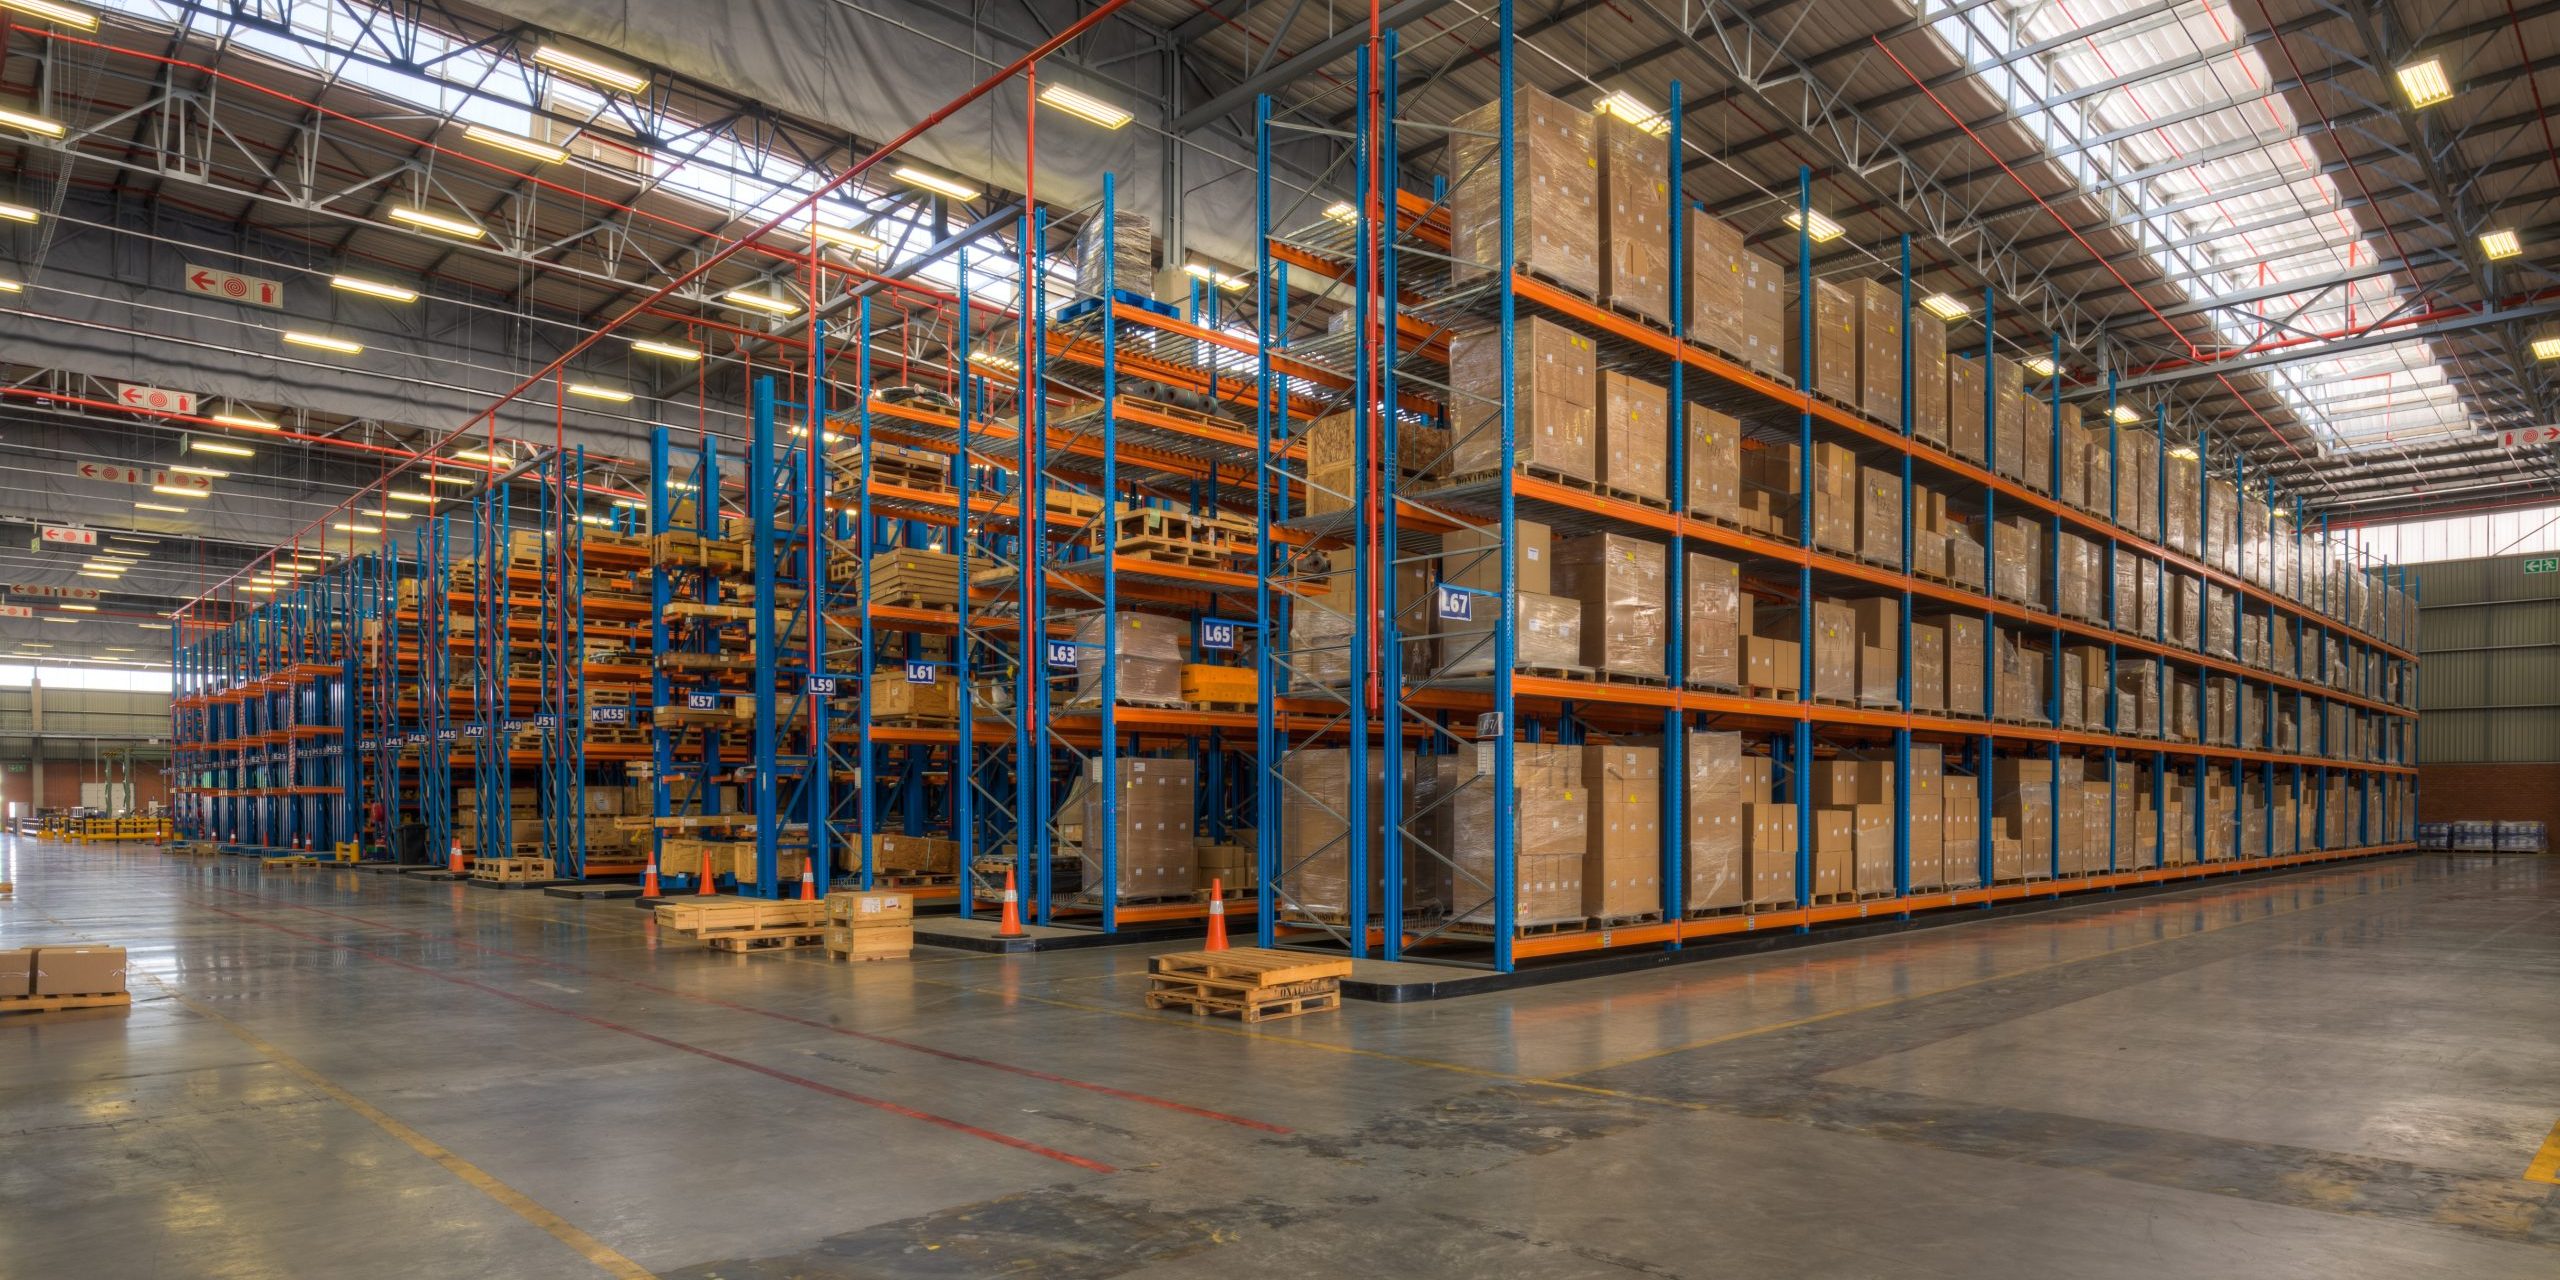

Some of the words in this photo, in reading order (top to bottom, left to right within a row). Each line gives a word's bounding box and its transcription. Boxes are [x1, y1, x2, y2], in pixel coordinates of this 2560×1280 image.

[1456, 470, 1502, 485] DONALDSO
[1441, 590, 1468, 614] L67
[1206, 625, 1231, 643] L65
[1050, 645, 1075, 663] L63
[909, 664, 933, 680] L61
[810, 678, 834, 692] L59
[690, 695, 713, 707] K57
[603, 708, 624, 720] K55
[503, 720, 521, 730] J49
[536, 716, 554, 726] J51
[439, 730, 456, 739] J45
[465, 726, 483, 735] J47
[386, 738, 402, 746] J41
[409, 733, 425, 742] J43
[327, 745, 342, 753] H35
[360, 741, 376, 749] J39
